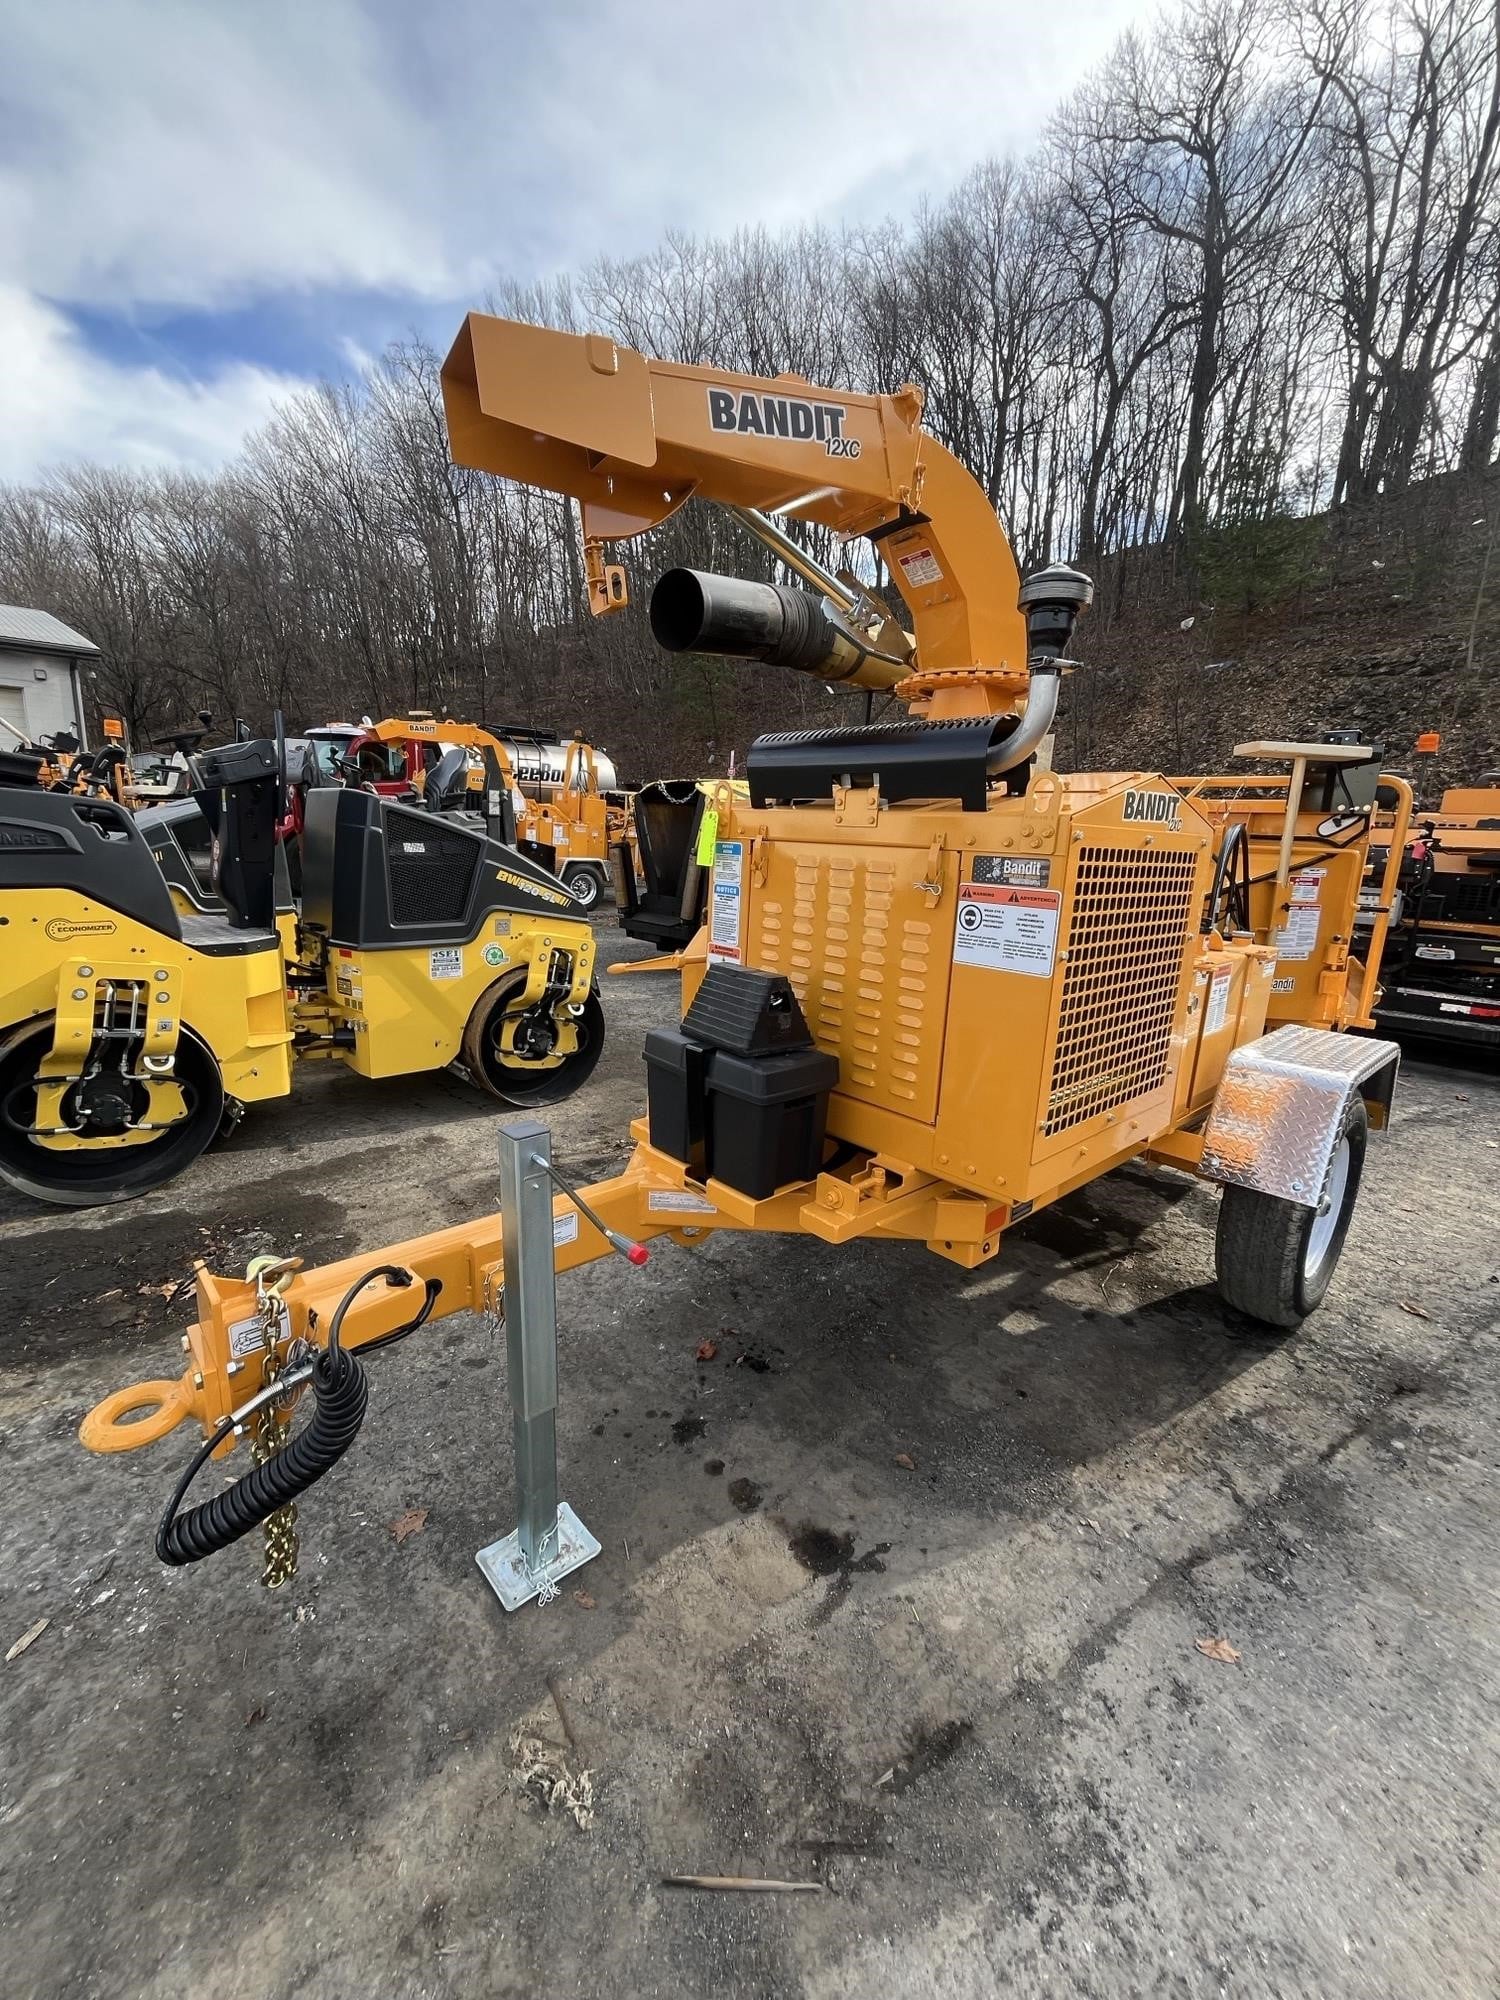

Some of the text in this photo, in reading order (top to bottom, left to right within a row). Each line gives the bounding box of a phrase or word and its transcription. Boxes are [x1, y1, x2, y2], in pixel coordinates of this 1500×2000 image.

[708, 389, 845, 441] BANDIT
[824, 438, 861, 459] 12XC
[409, 724, 436, 733] BANDIT
[512, 763, 565, 783] eeBo
[1123, 790, 1180, 821] BANDIT
[1167, 819, 1183, 832] 12XC
[1003, 859, 1041, 876] Bandit
[716, 886, 738, 896] NOTICE
[57, 925, 113, 933] ECONOMIZER
[1271, 977, 1295, 989] andit
